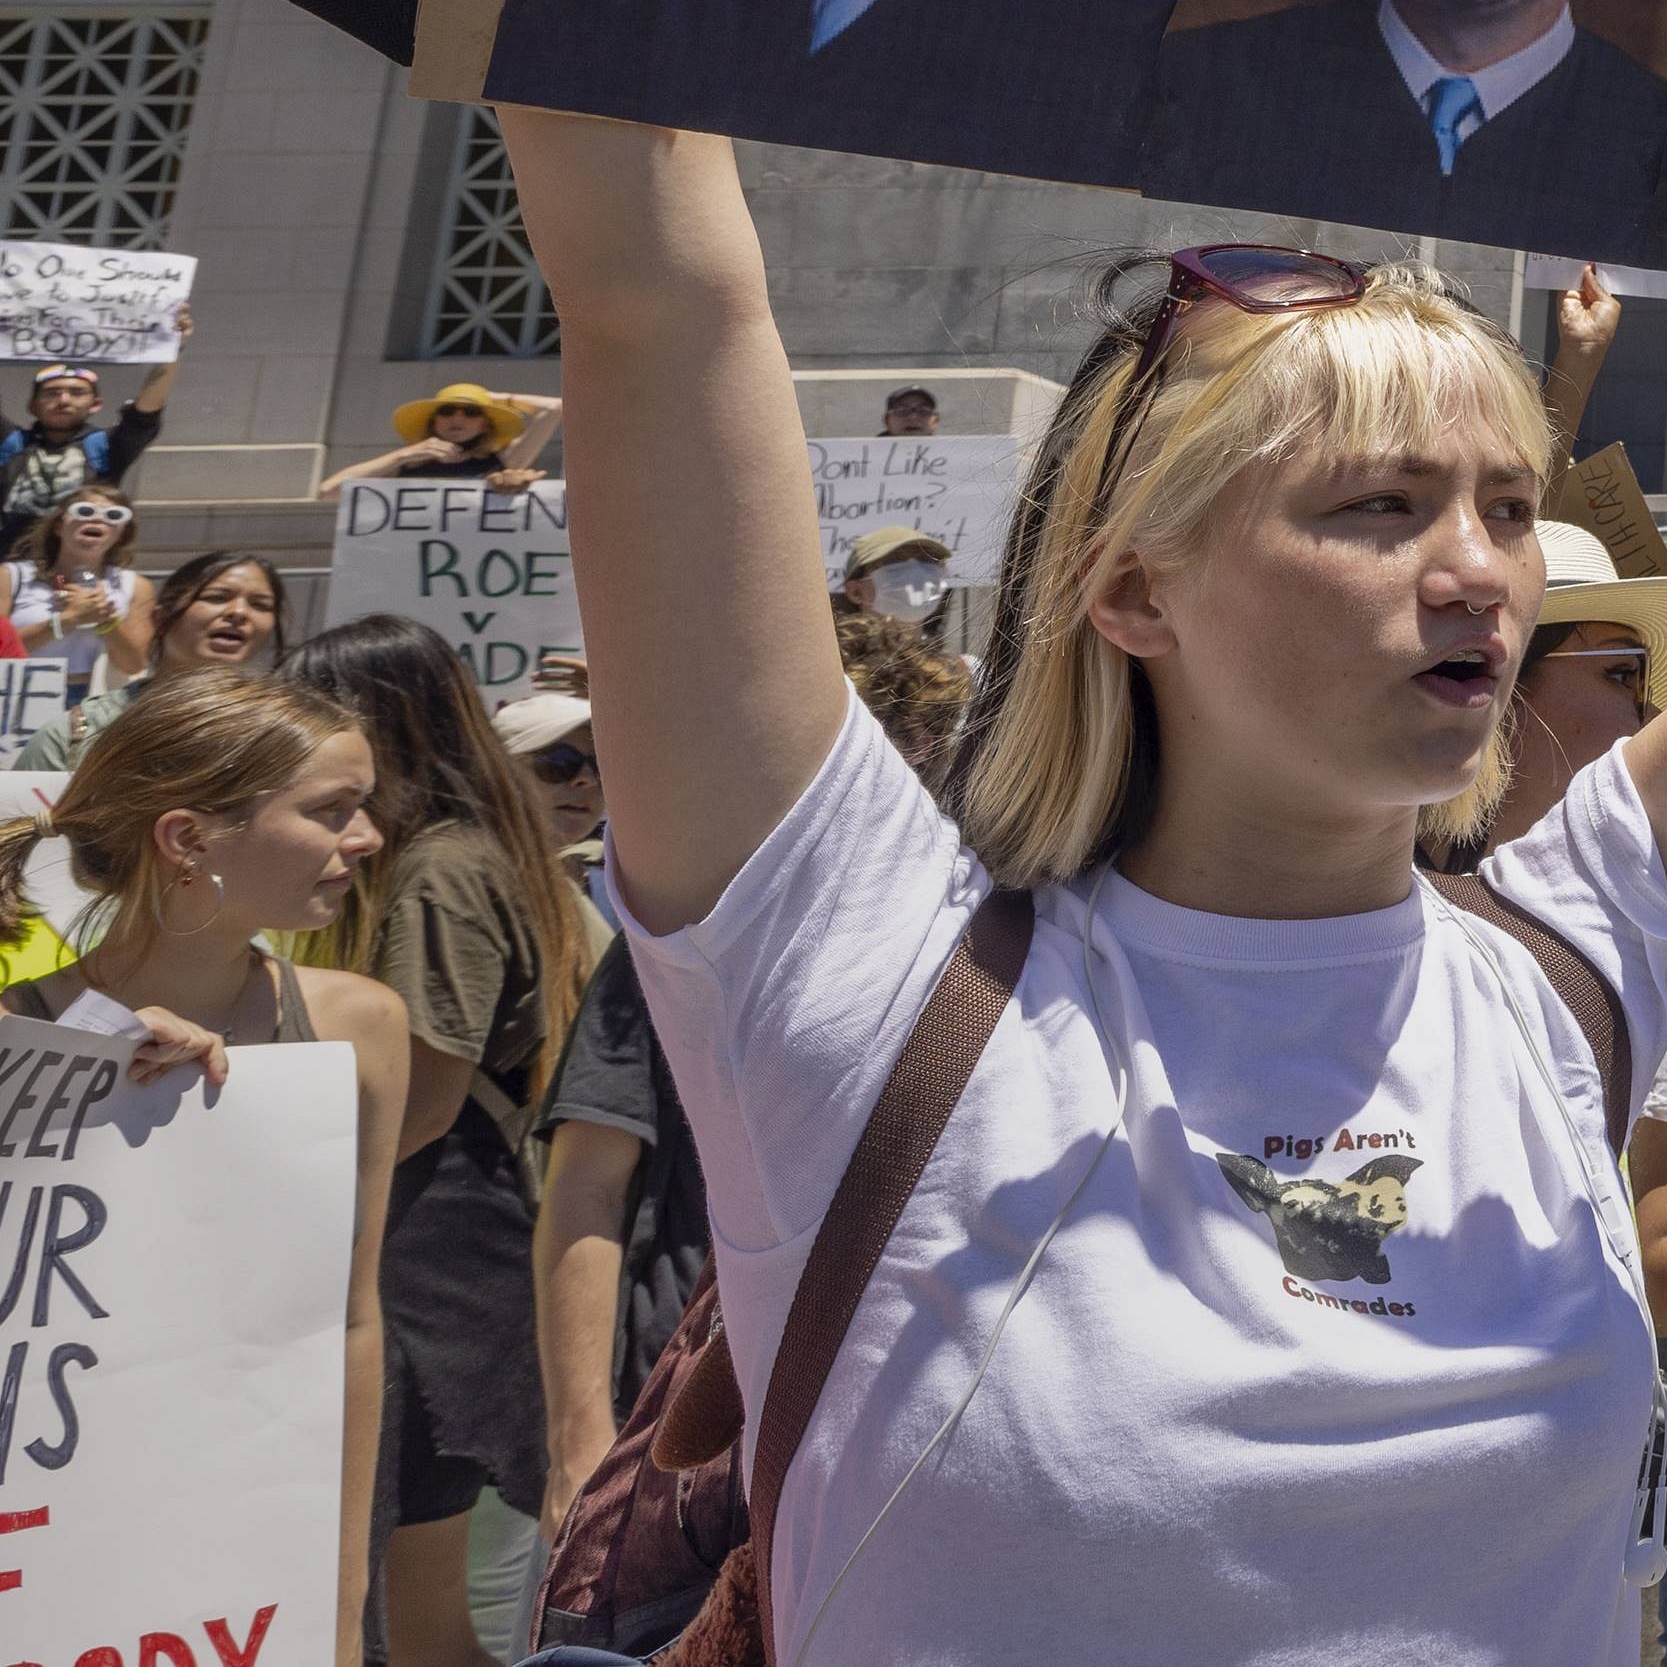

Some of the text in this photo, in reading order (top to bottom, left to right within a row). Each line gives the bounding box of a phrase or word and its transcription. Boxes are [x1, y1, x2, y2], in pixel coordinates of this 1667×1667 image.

[883, 441, 948, 477] Like
[420, 539, 570, 598] ROE
[1264, 1127, 1417, 1162] Pigs Aren't
[1282, 1275, 1416, 1319] Comrades
